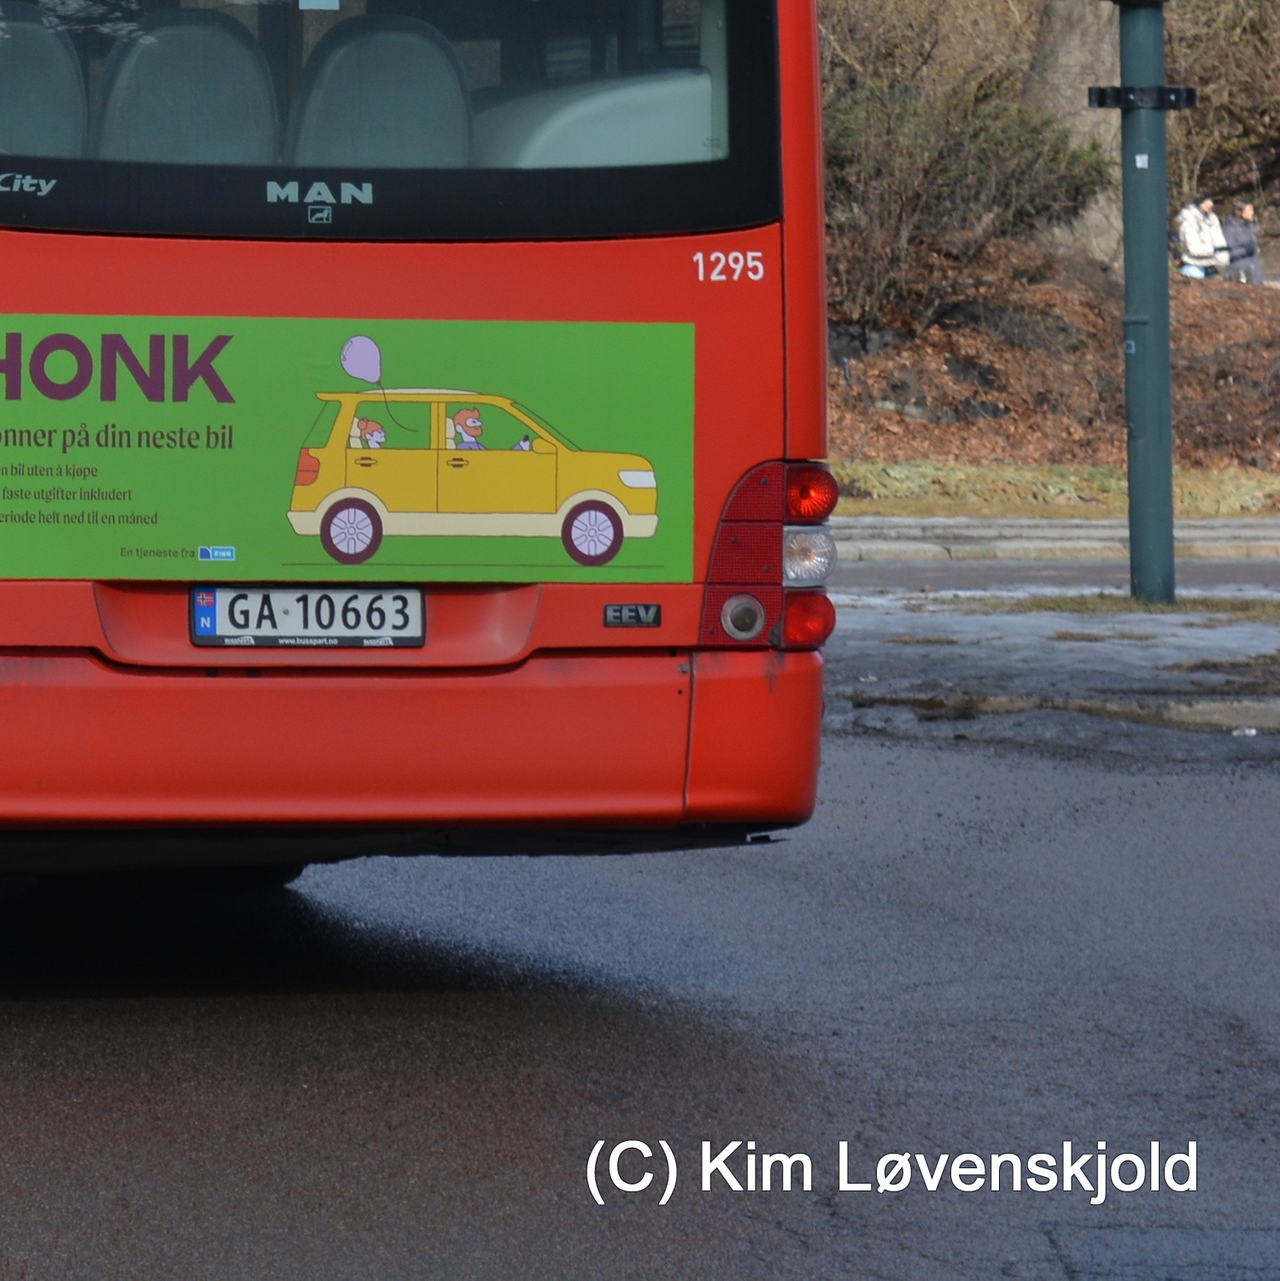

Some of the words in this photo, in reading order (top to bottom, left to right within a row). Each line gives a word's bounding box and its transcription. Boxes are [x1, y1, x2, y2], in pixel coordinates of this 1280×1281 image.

[266, 181, 373, 204] MAN
[692, 251, 765, 281] 1295
[61, 423, 90, 454] på
[95, 424, 132, 449] din
[137, 426, 200, 449] neste
[206, 424, 233, 449] bil
[10, 463, 25, 476] bil
[27, 464, 53, 477] uten
[55, 464, 63, 477] å
[65, 464, 98, 480] kjøpe
[2, 486, 31, 500] faste
[33, 487, 78, 503] utgifter
[79, 487, 132, 501] inkludert
[38, 511, 60, 524] helt
[62, 511, 85, 524] ned
[87, 511, 98, 524] til
[101, 514, 116, 525] en
[117, 512, 158, 525] måned
[120, 547, 133, 557] En
[135, 547, 179, 559] tjeneste
[181, 547, 195, 557] fra
[227, 593, 278, 630] GA
[295, 593, 410, 630] 10663
[606, 605, 658, 624] EEV
[200, 617, 211, 628] N
